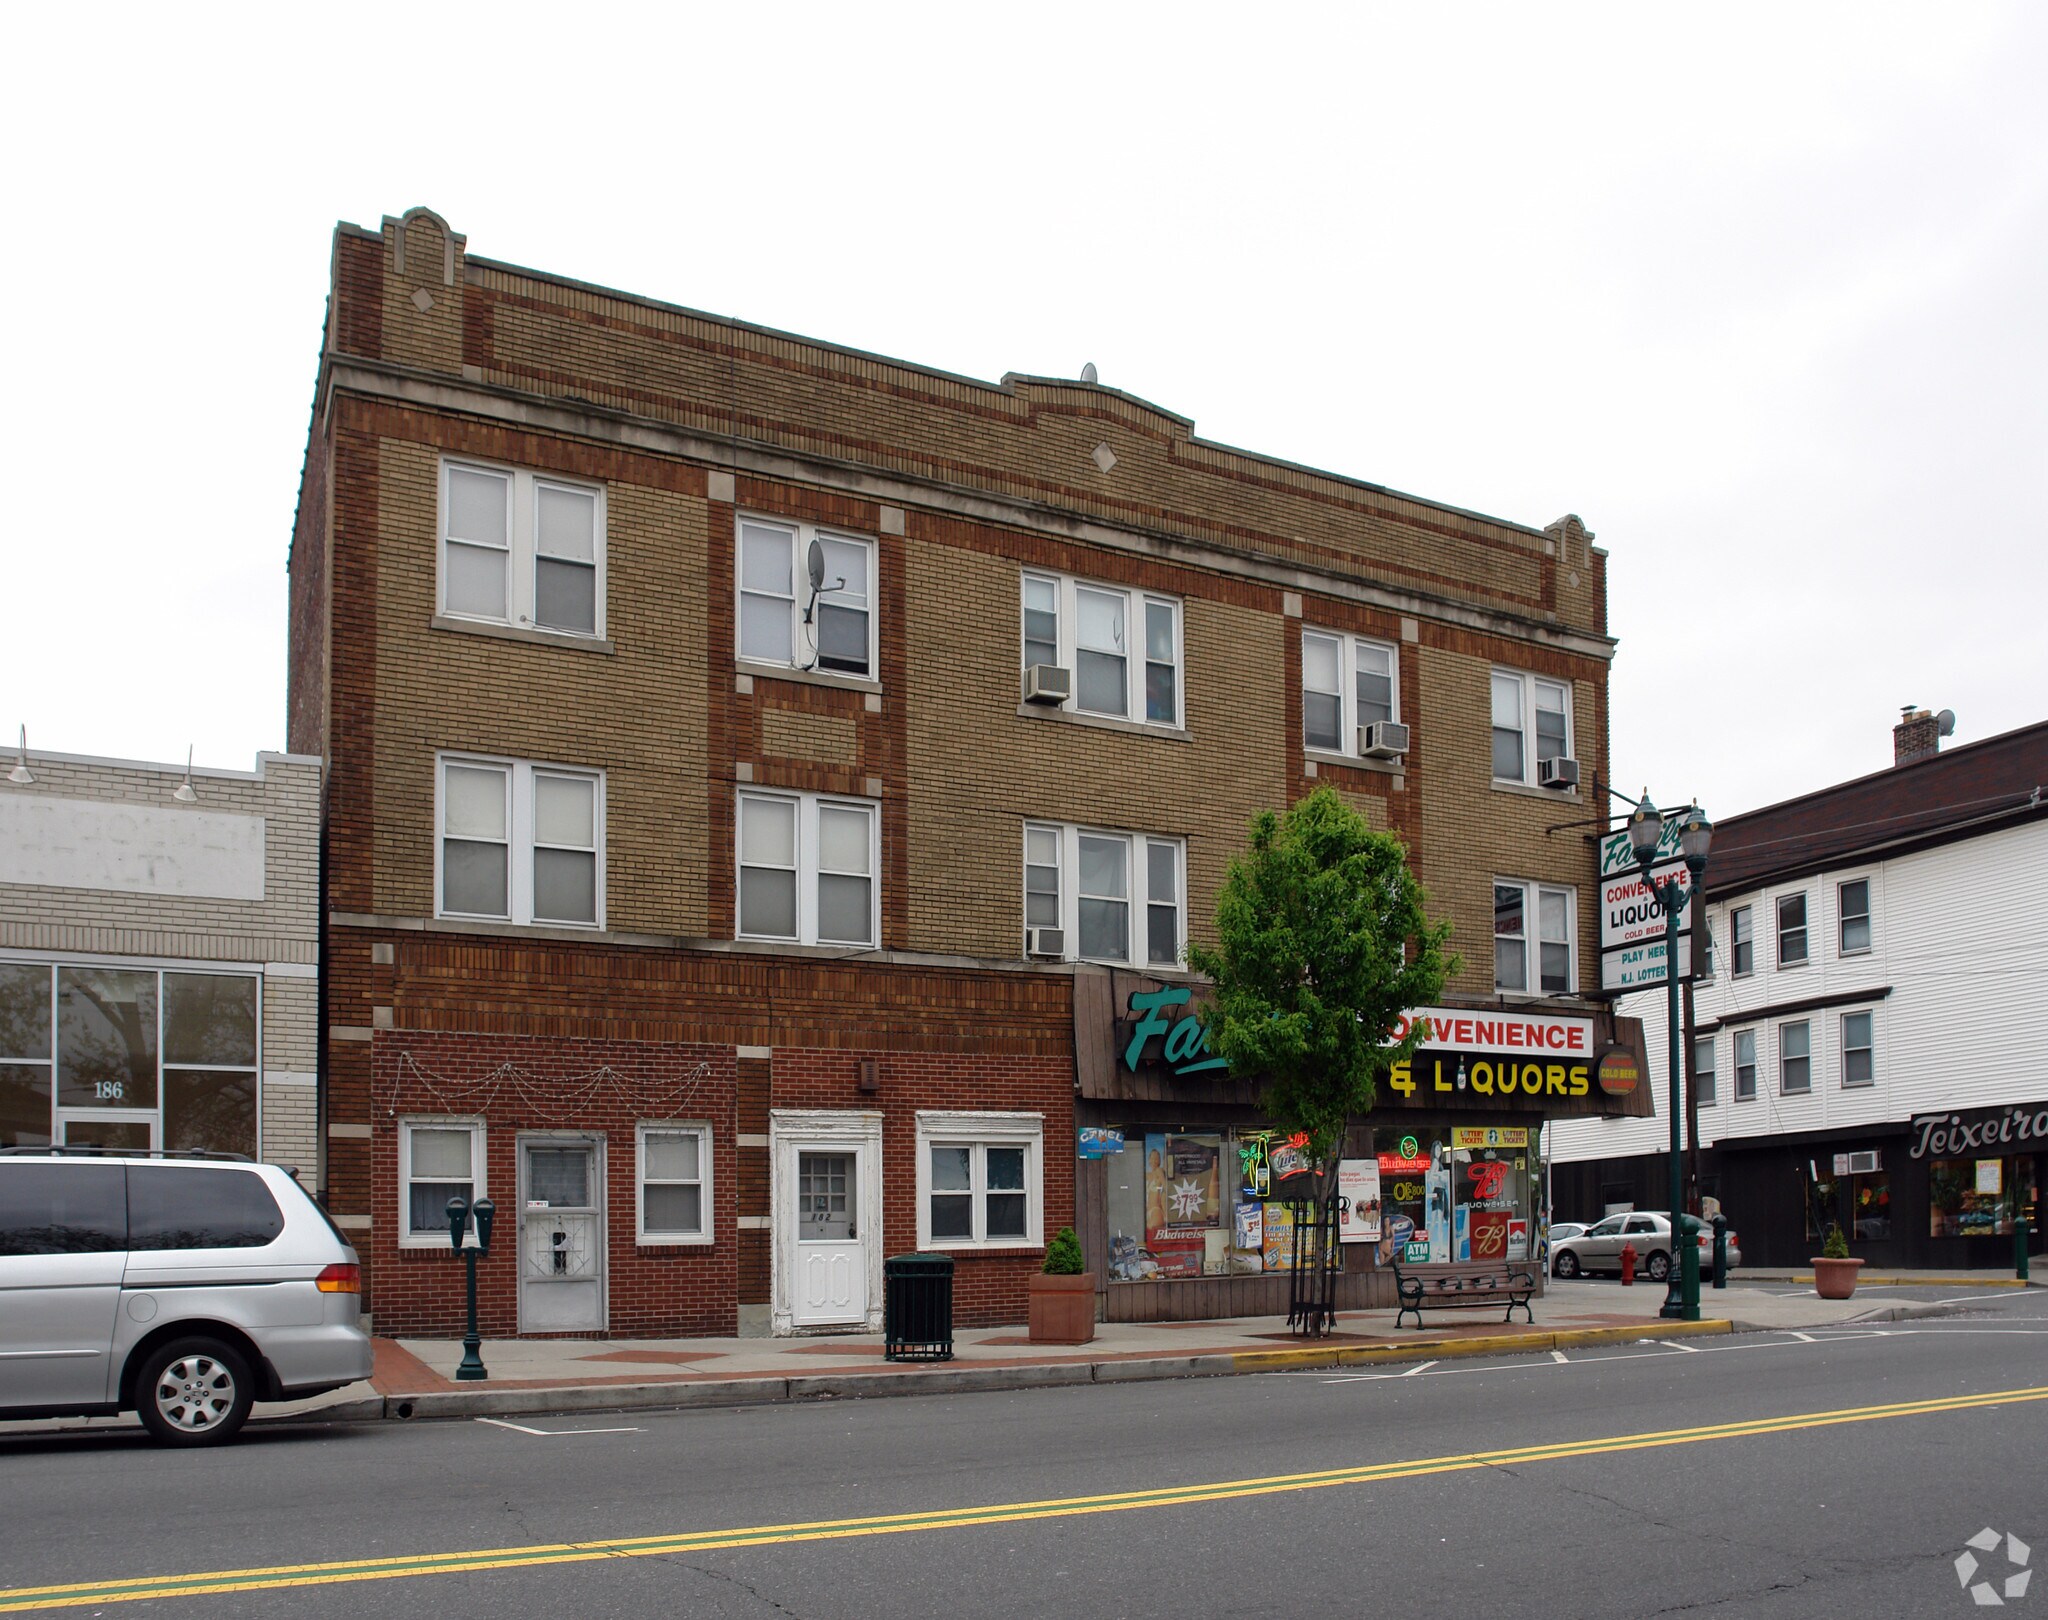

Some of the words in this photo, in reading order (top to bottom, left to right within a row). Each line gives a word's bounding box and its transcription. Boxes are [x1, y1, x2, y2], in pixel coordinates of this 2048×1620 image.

[1603, 818, 1682, 874] Faily
[1607, 869, 1687, 903] CONVENENCE
[1611, 900, 1684, 929] LIQUO
[1625, 929, 1643, 940] COLD
[1646, 924, 1665, 935] BEER
[1622, 949, 1643, 964] PLAY
[1648, 944, 1668, 960] HER
[1621, 972, 1634, 984] N.J.
[1638, 965, 1668, 981] LOTTER
[1386, 1015, 1585, 1050] ONVENIENCE
[1389, 1060, 1417, 1098] &
[1601, 1067, 1618, 1078] COLD
[1619, 1068, 1637, 1079] BEER
[93, 1081, 123, 1100] 186
[1080, 1129, 1123, 1143] CAMEL
[1463, 1199, 1519, 1208] BUDWEISER
[812, 1213, 831, 1221] 182
[1407, 1243, 1428, 1256] ATM
